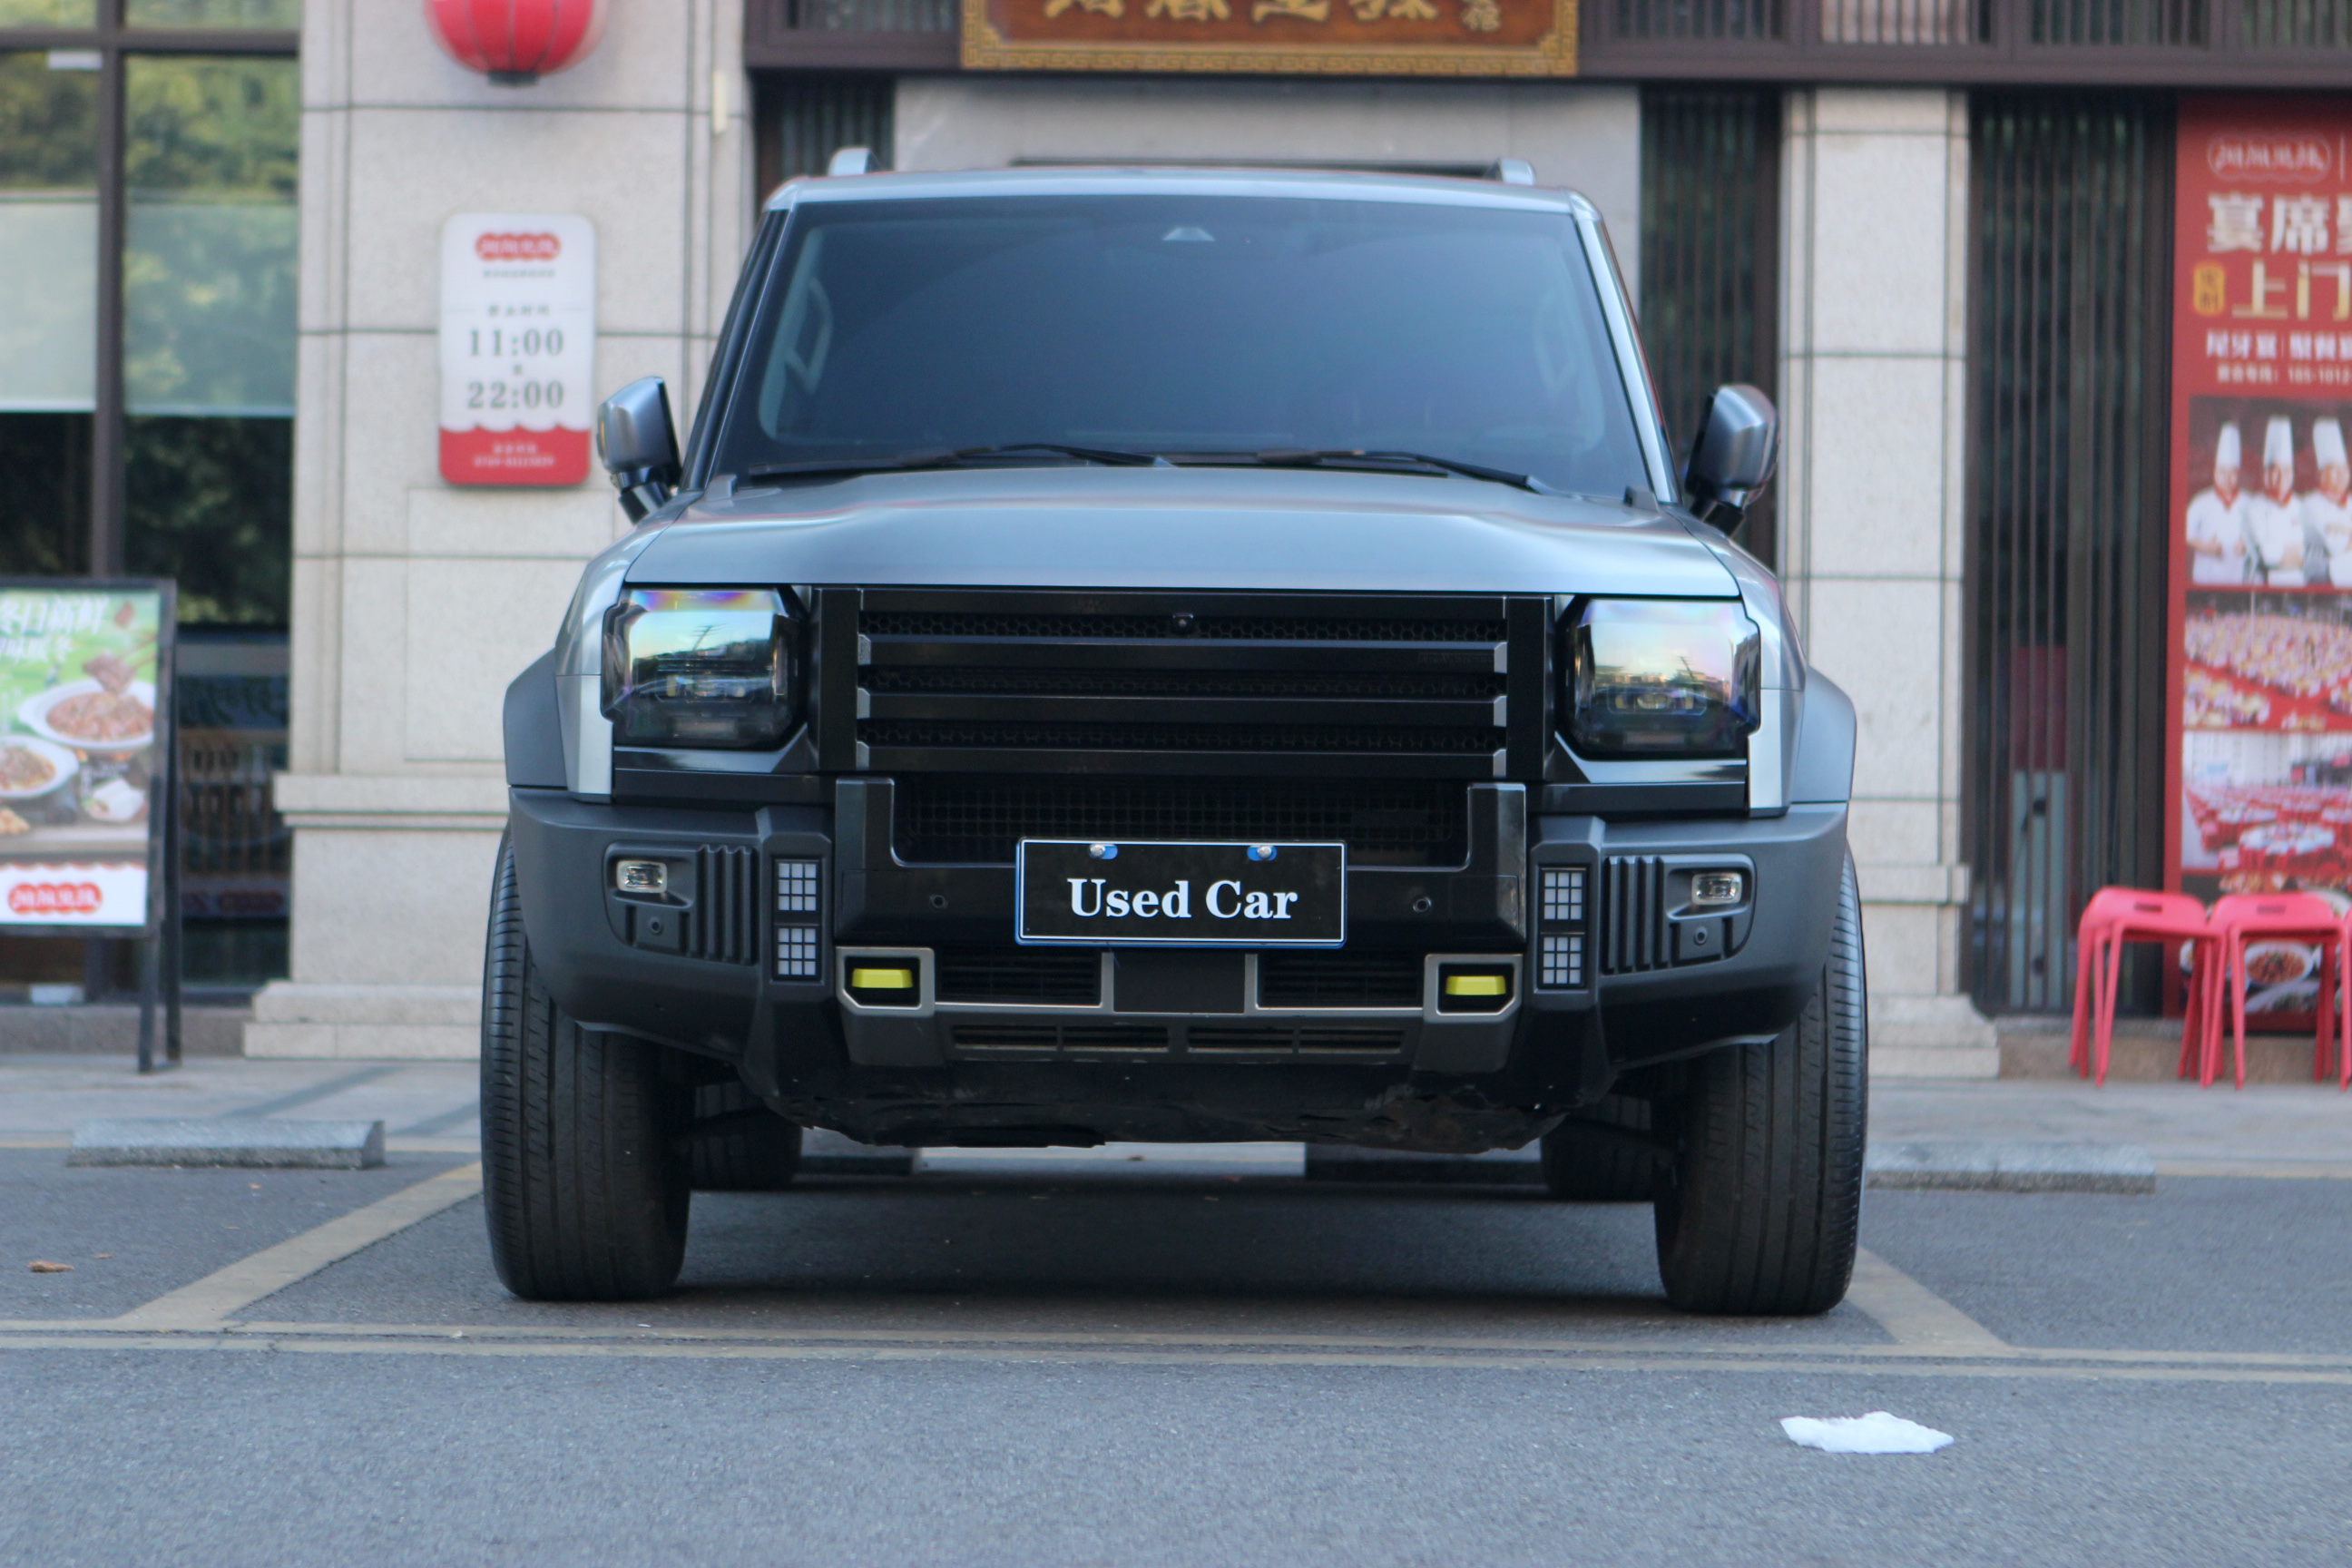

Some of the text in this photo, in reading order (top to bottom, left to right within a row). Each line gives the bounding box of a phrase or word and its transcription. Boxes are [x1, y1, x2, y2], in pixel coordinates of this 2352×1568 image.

[2206, 191, 2352, 255] 宴席
[469, 328, 564, 357] 11:00
[467, 380, 564, 409] 22:00
[1067, 878, 1298, 919] Used Car
